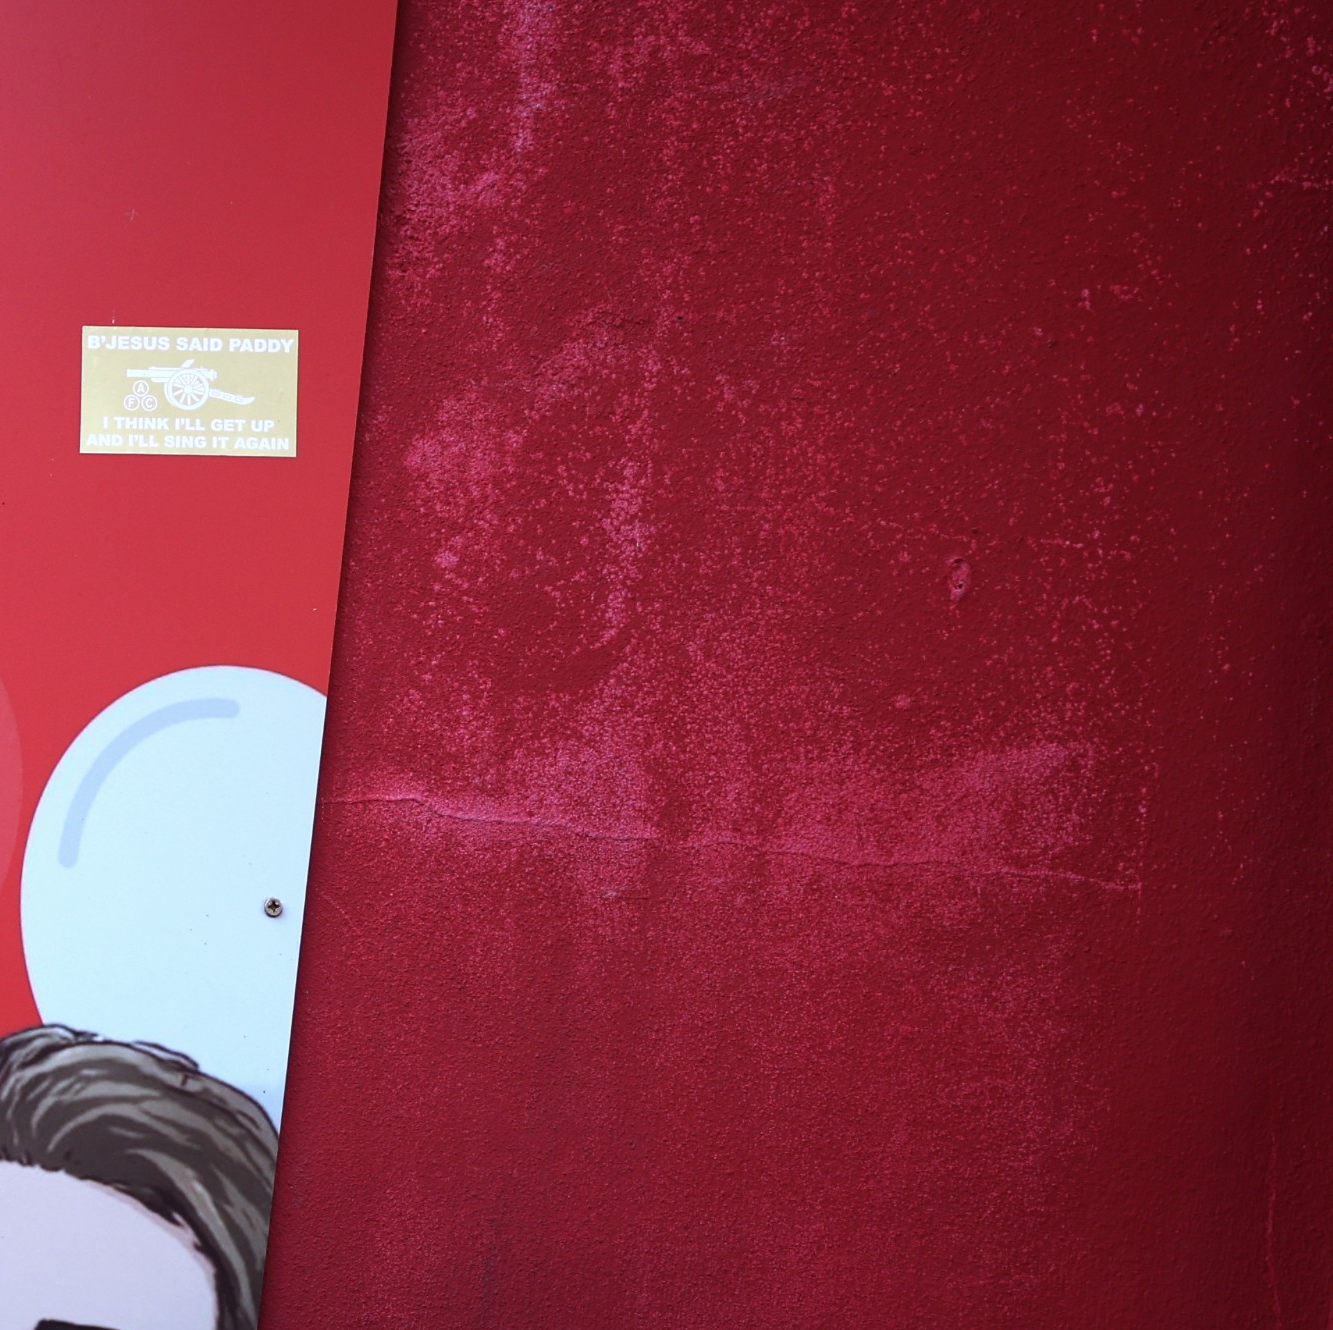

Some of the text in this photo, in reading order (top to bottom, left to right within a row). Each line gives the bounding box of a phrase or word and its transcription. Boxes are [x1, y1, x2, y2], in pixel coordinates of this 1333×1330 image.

[87, 334, 294, 353] B'JESUS SAID PADDY
[103, 416, 275, 433] I THINK I'LL GET UP
[86, 434, 290, 450] AND I'LL SING IT AGAIN
